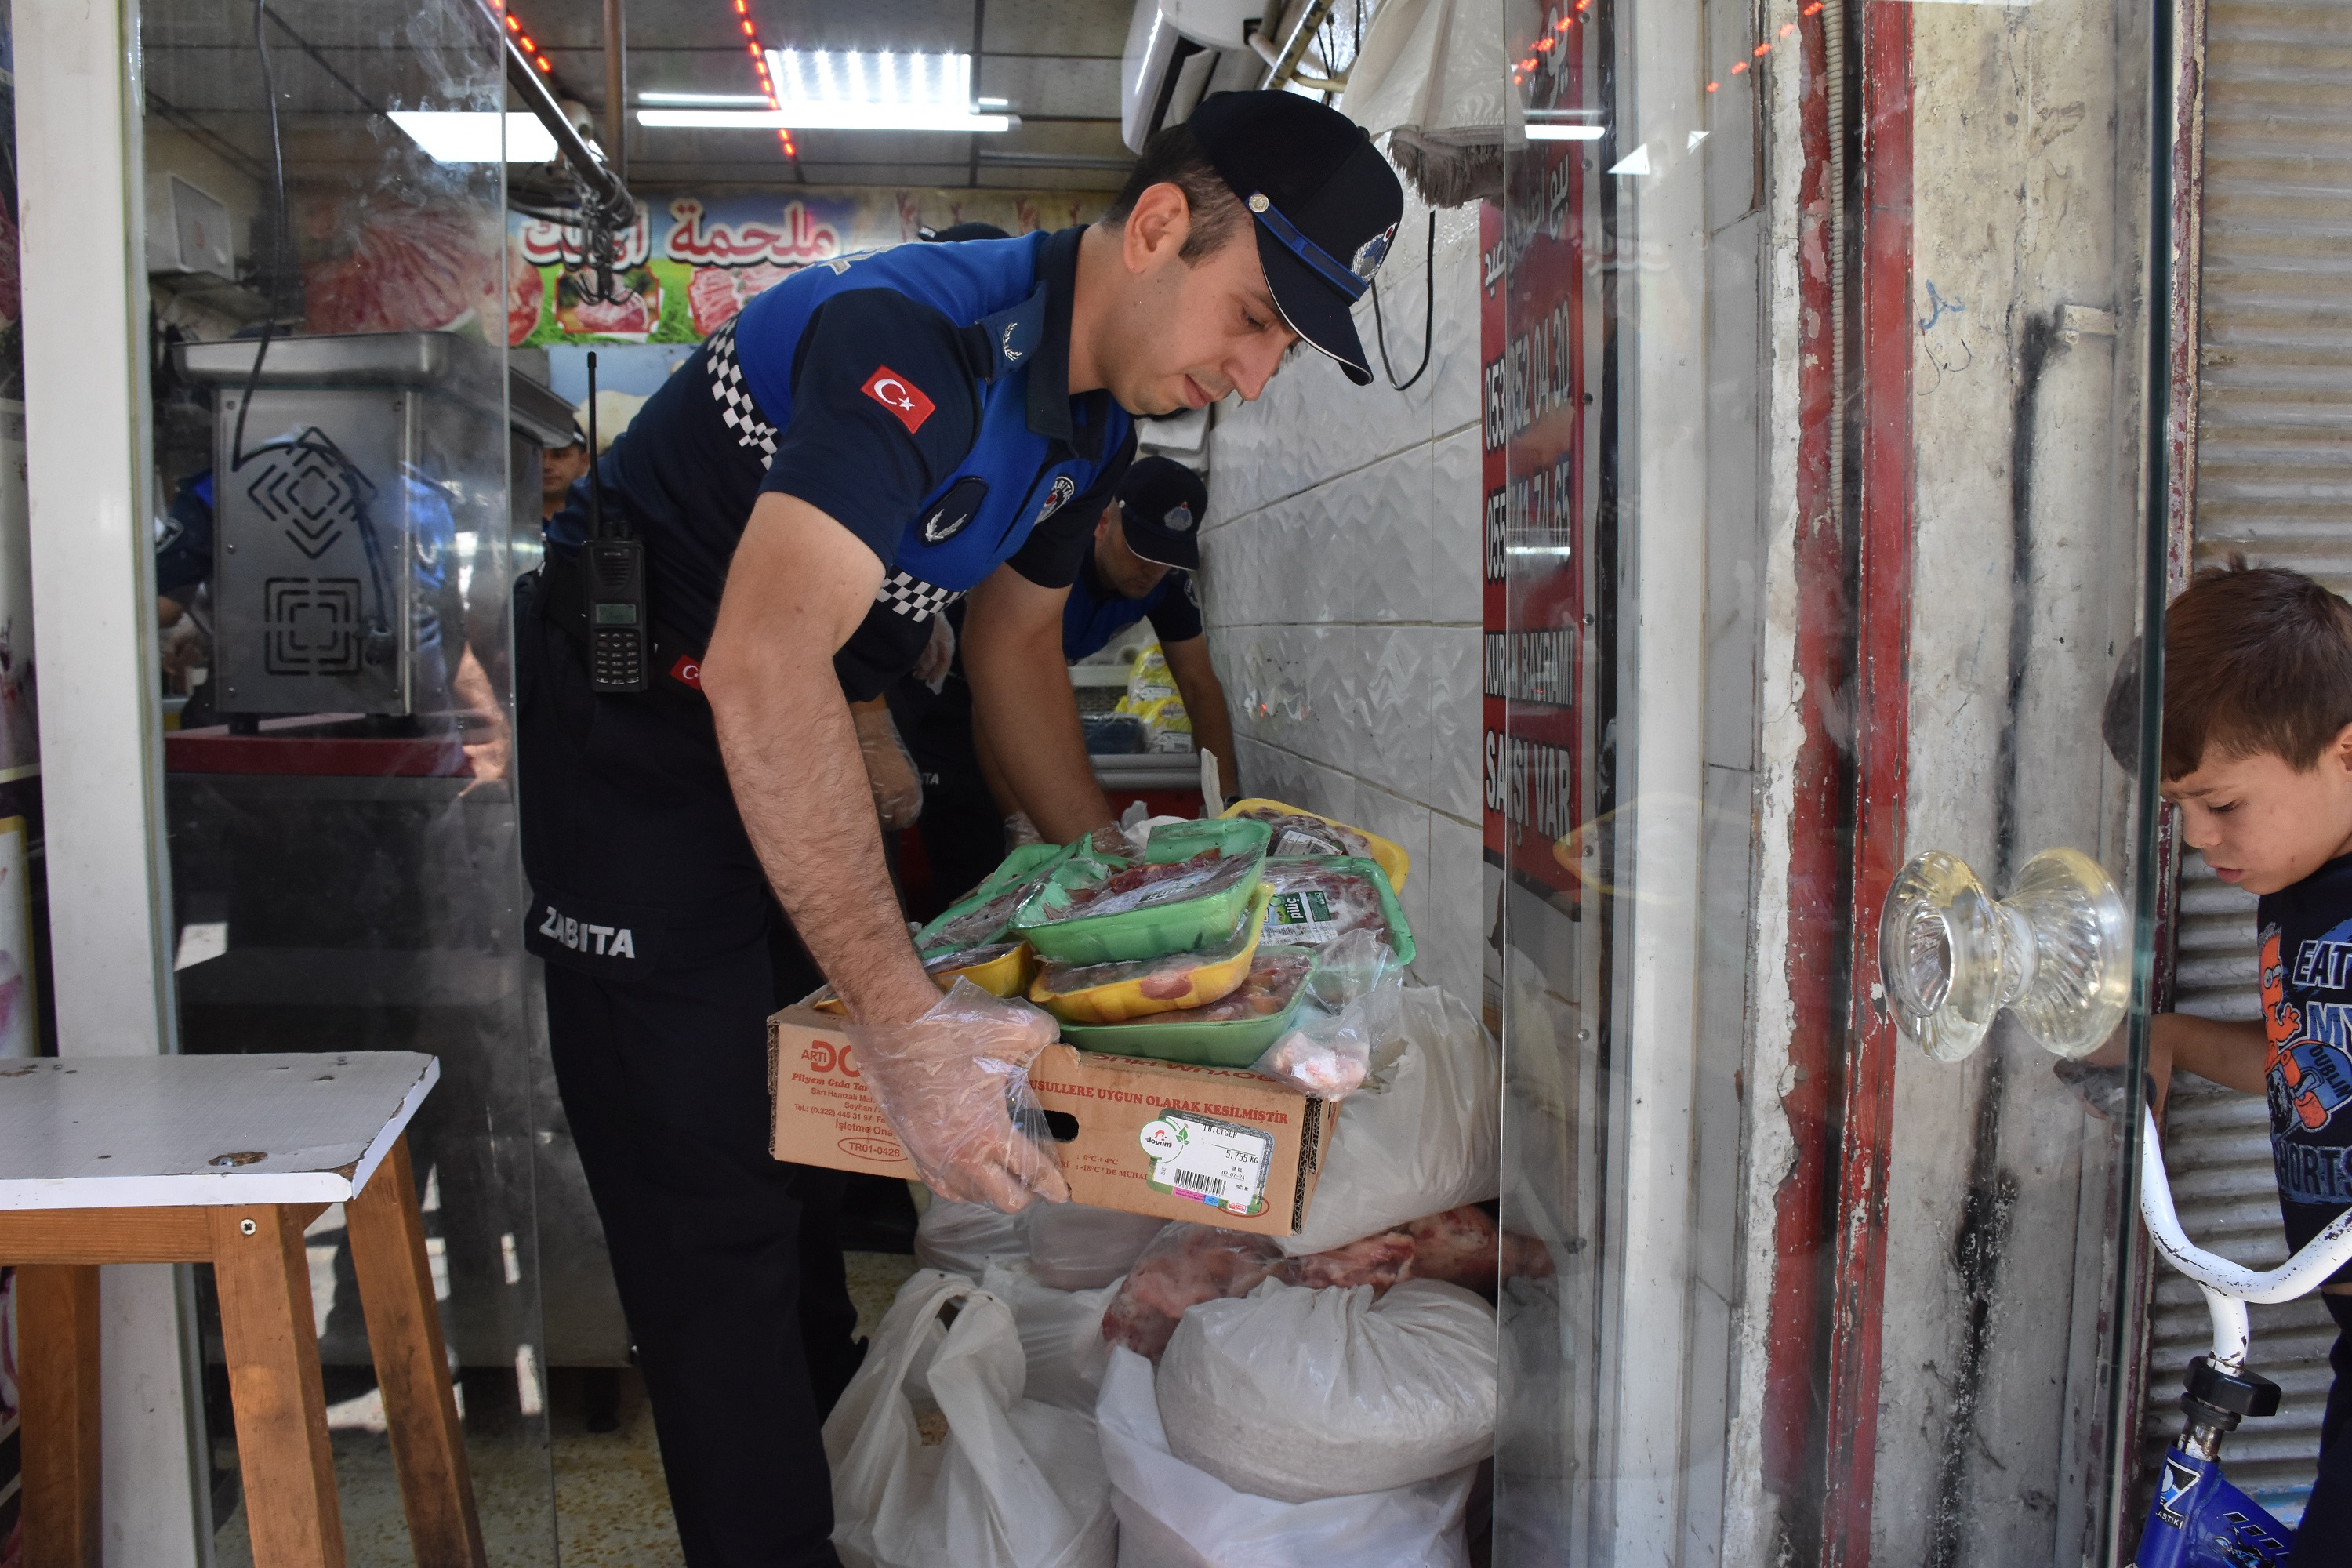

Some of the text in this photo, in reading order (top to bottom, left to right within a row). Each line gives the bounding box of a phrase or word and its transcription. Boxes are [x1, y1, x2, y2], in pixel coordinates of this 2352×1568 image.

[668, 201, 839, 265] ملحمة
[1534, 324, 1551, 421] 04
[1553, 299, 1570, 408] 30
[1521, 630, 1573, 706] BAYRAMI
[1534, 743, 1572, 847] VAR
[1285, 898, 1304, 919] piliç
[539, 906, 635, 959] ZABITA
[2292, 940, 2352, 990] EAT
[801, 1049, 827, 1063] ARTI
[2309, 1044, 2352, 1098] DUBLIN
[791, 1073, 825, 1086] Pilyem
[828, 1079, 851, 1089] Gıda
[811, 1087, 826, 1096] Sarı
[828, 1090, 858, 1101] Hamzalı
[1029, 1080, 1094, 1098] USULLERE
[1097, 1088, 1143, 1104] UYGUN
[1145, 1095, 1200, 1112] OLARAK
[1203, 1104, 1289, 1124] KESİLMİŞTİR
[811, 1106, 836, 1117] (0.322)
[844, 1102, 873, 1112] Seyhan
[835, 1118, 871, 1134] İşletme
[849, 1142, 901, 1158] TR01-0428
[1145, 1136, 1173, 1149] doyum
[1225, 1149, 1259, 1164] 5.755 KG
